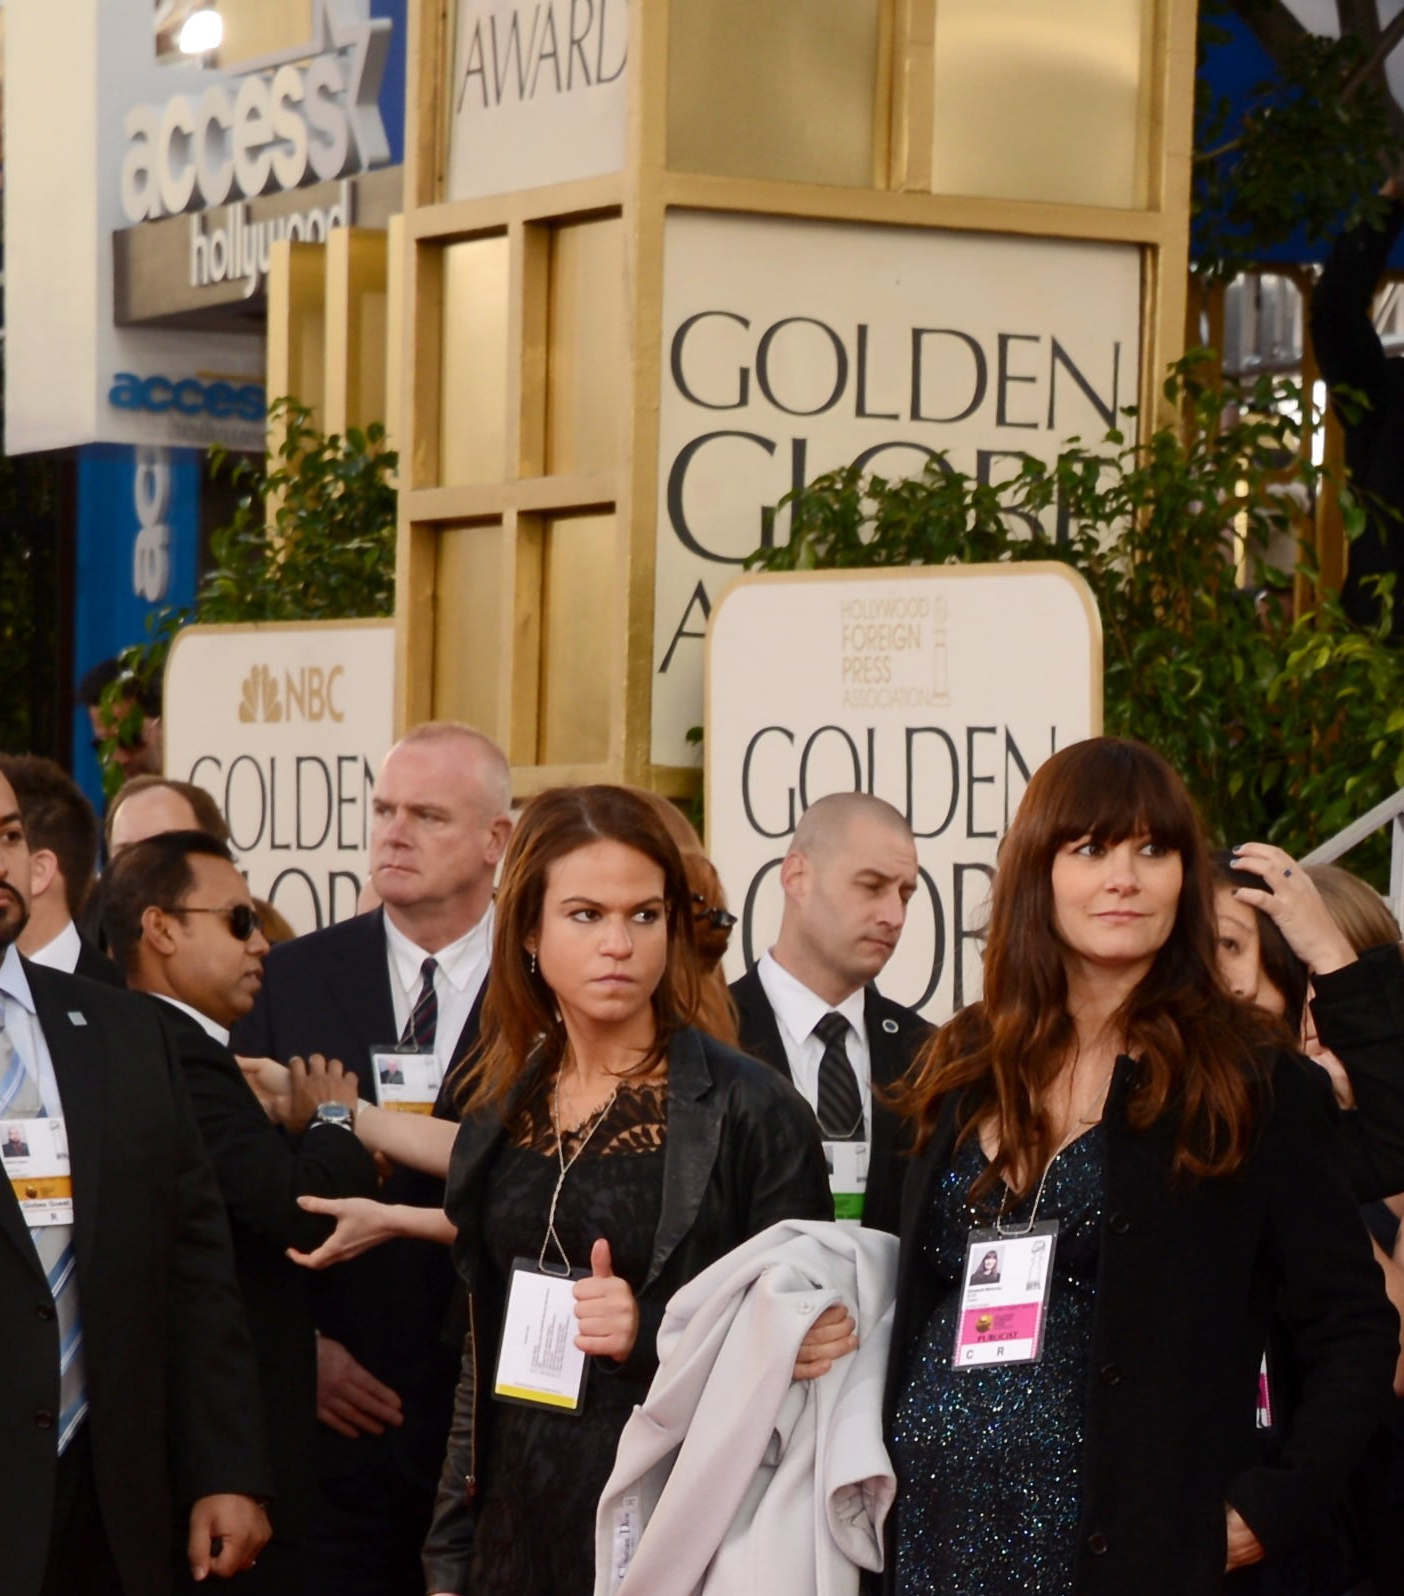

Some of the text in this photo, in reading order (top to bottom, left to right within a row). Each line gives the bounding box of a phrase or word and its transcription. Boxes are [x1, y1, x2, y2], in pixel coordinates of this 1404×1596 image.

[121, 55, 349, 224] access
[670, 310, 1121, 432] GOLDEN
[108, 371, 268, 422] acces
[841, 597, 930, 620] HOLLYWOOD
[842, 623, 922, 652] FOREIGN
[842, 655, 892, 684] PRESS
[285, 664, 345, 723] NBC
[977, 1331, 1018, 1343] PUBLICIST
[966, 1346, 1005, 1360] C R
